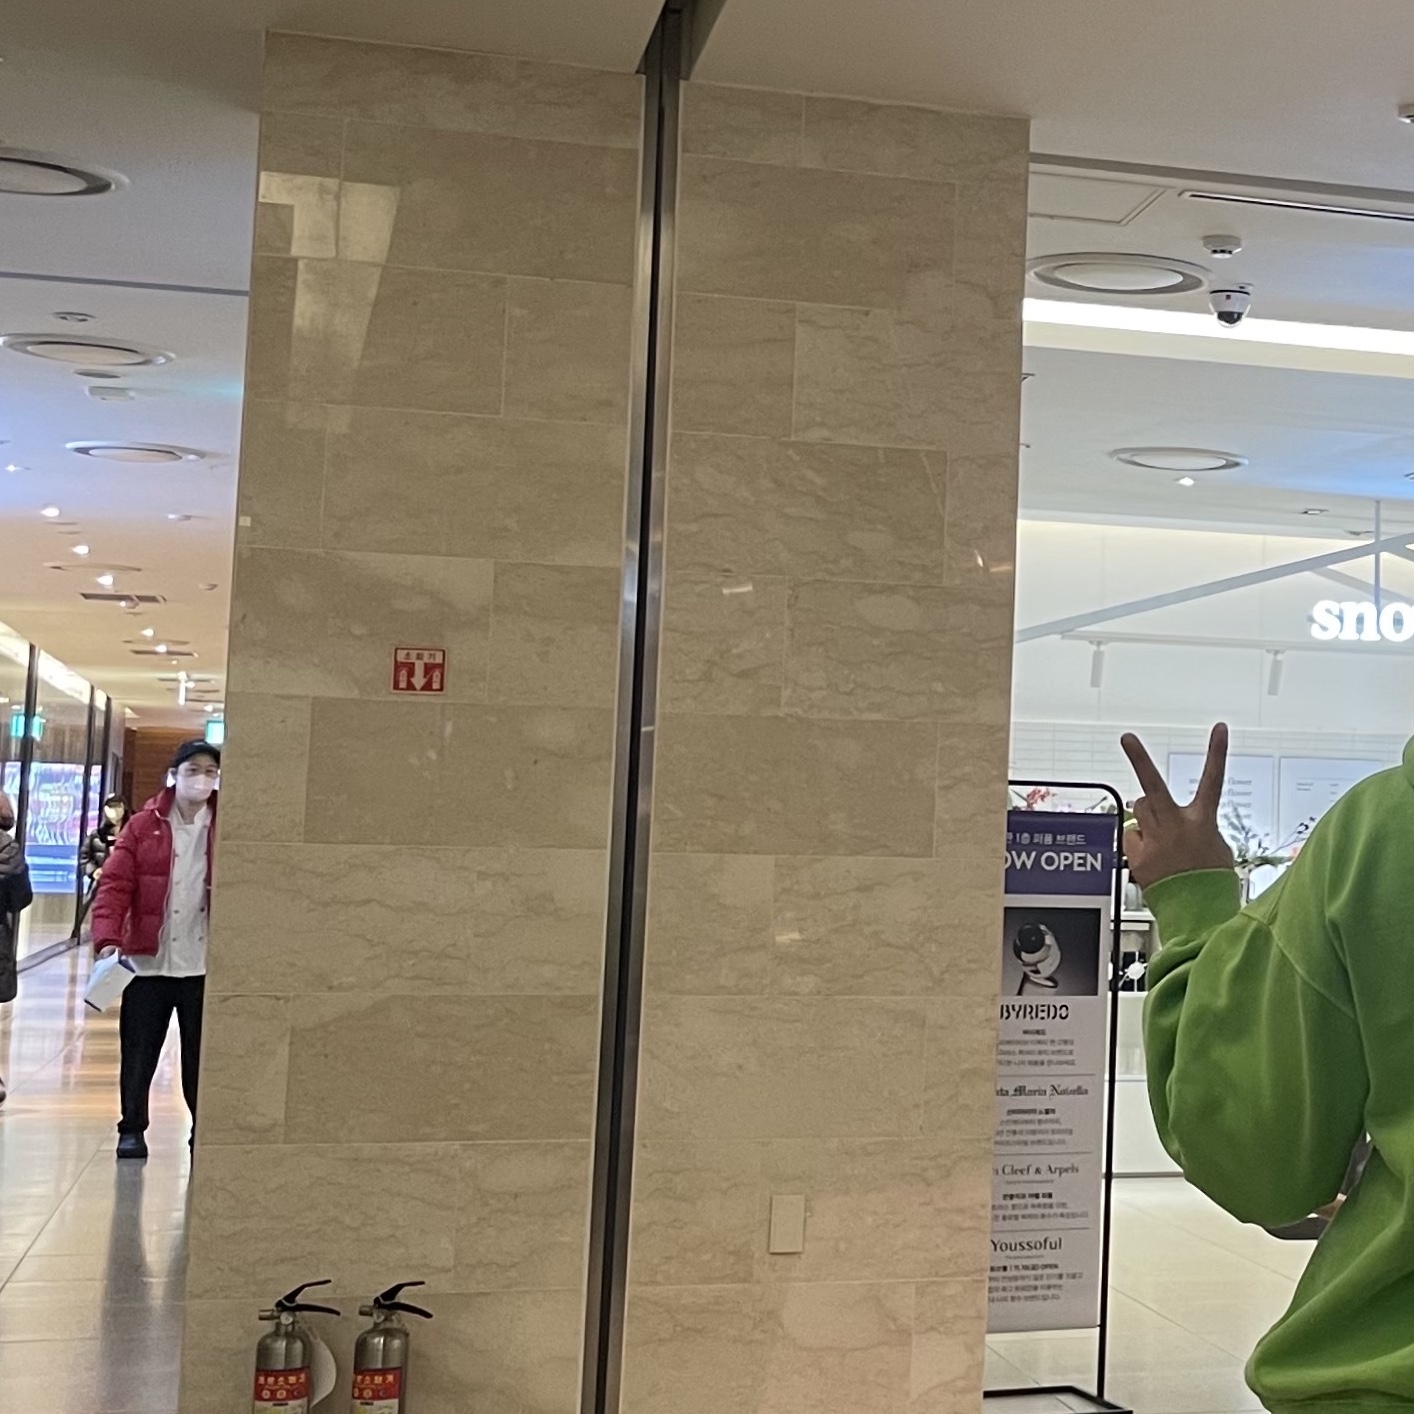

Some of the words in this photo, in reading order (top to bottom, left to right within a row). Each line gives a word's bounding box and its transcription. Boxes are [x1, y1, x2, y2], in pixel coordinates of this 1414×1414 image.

[1055, 834, 1087, 846] 브랜드
[1040, 851, 1102, 872] OPEN
[1000, 1004, 1070, 1020] BYREDO
[1002, 1164, 1032, 1176] Cleef
[1047, 1163, 1079, 1178] Arpels
[990, 1236, 1063, 1252] Youssoful
